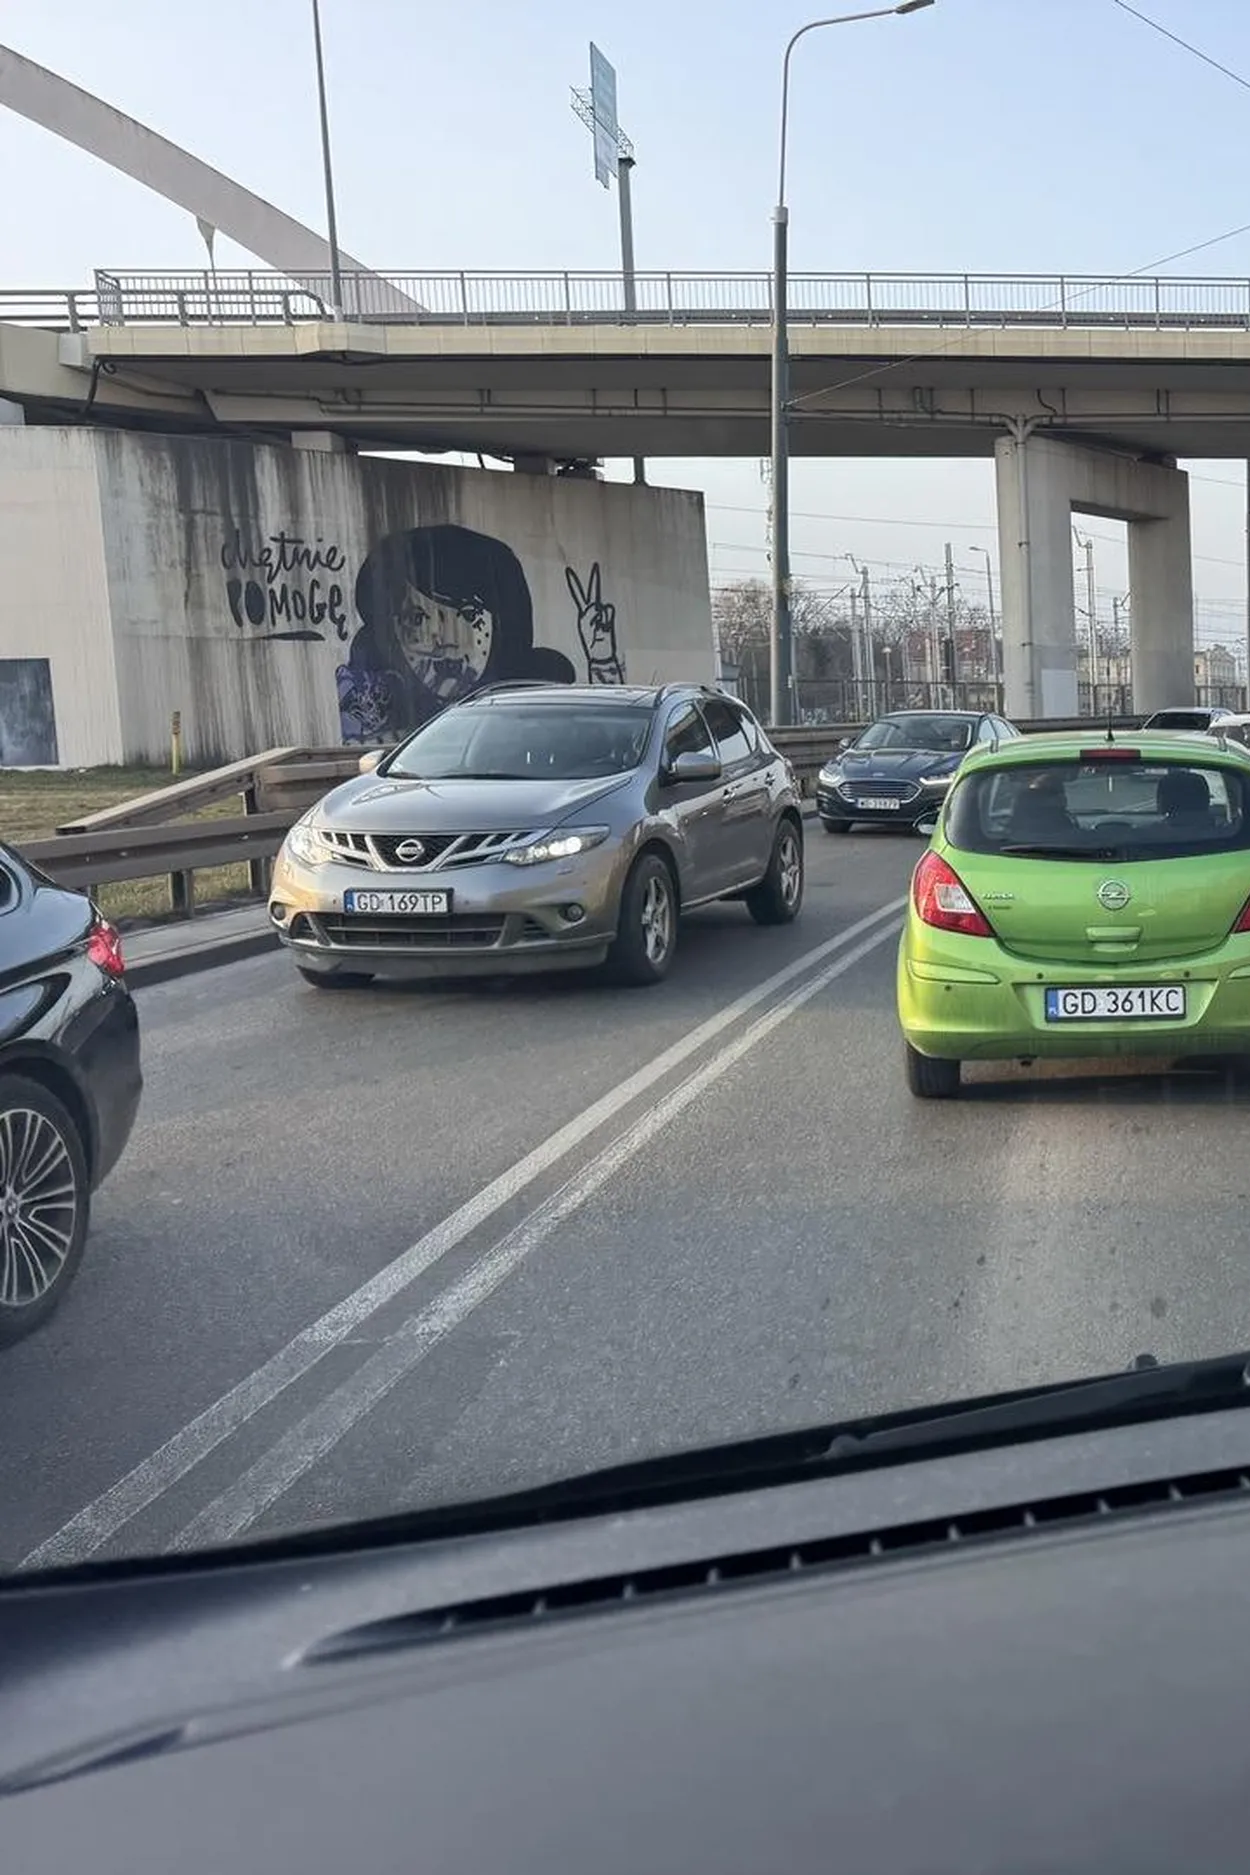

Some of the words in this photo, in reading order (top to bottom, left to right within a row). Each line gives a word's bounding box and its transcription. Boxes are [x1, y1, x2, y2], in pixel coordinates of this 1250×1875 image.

[357, 894, 380, 911] GD
[388, 894, 443, 912] 169TP
[1063, 992, 1097, 1015] GD
[1106, 989, 1179, 1014] 361KC
